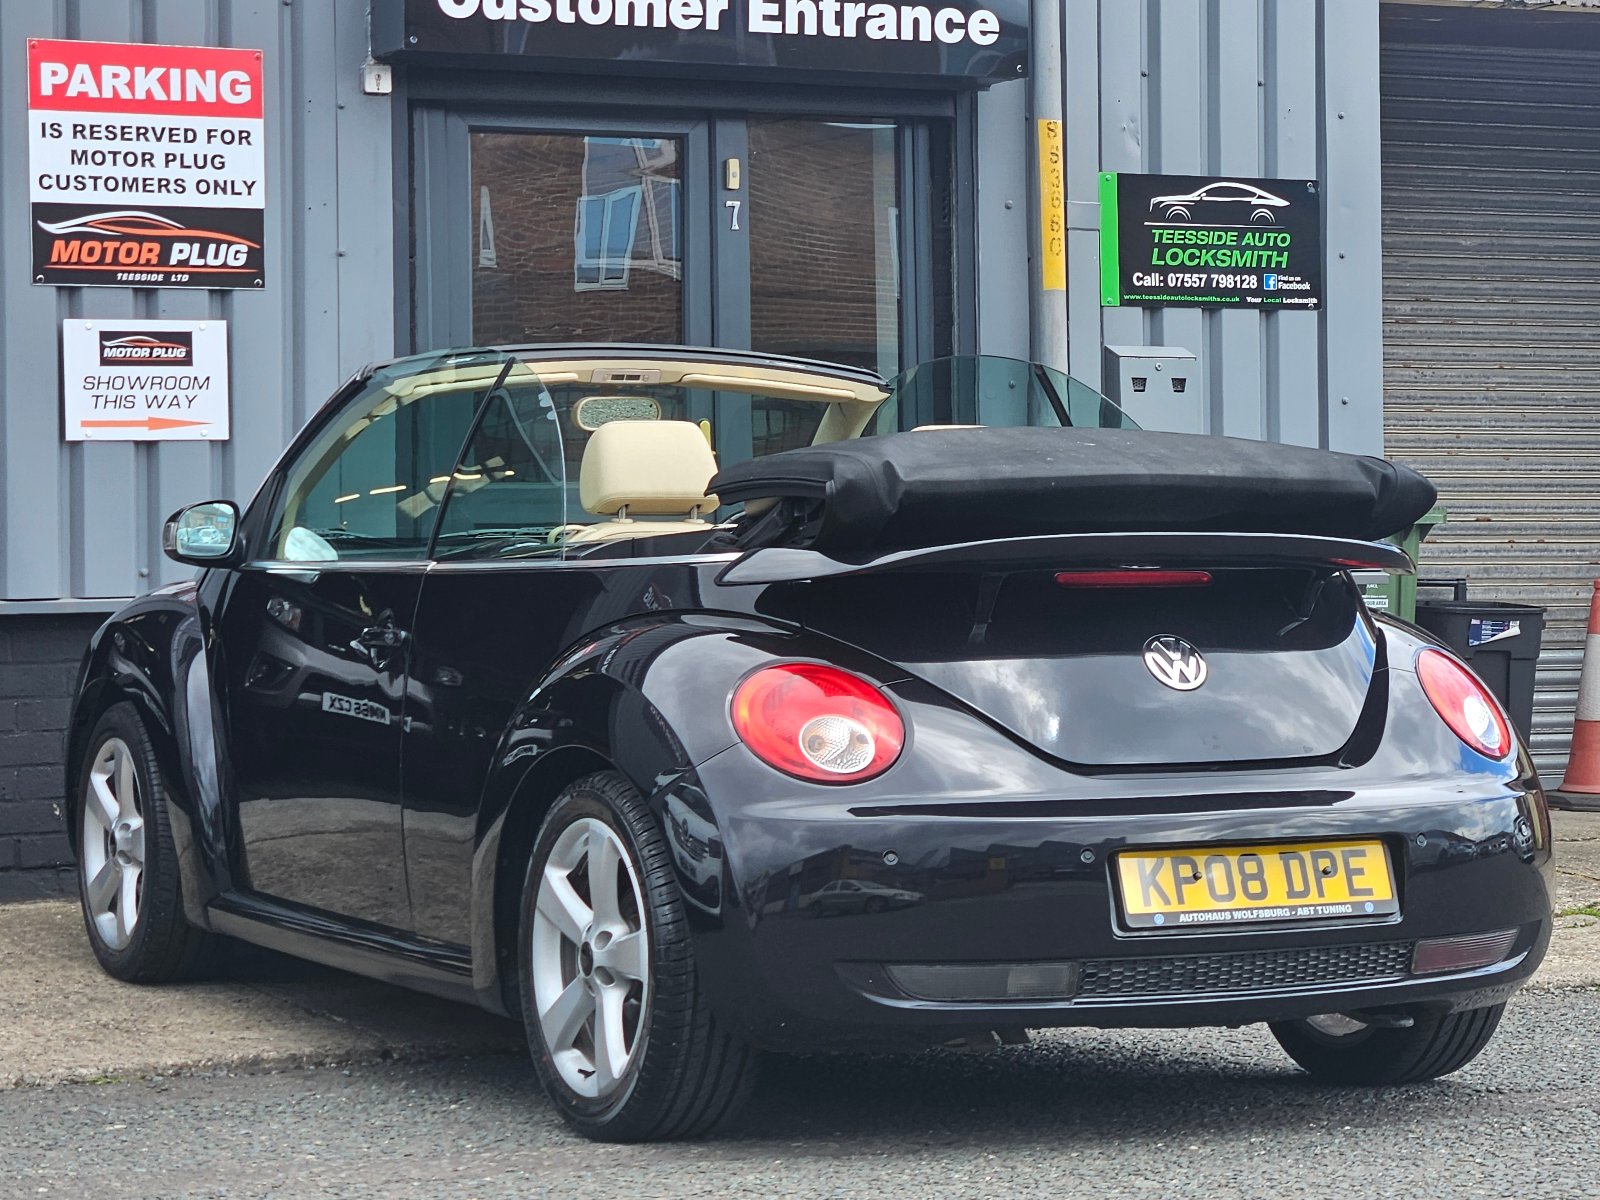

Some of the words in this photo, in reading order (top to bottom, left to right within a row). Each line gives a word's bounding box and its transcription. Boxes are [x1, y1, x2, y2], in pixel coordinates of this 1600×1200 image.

[748, 0, 1000, 45] Entrance
[40, 62, 251, 104] PARKING
[41, 122, 63, 139] IS
[72, 124, 198, 144] RESERVED
[206, 128, 252, 146] FOR
[70, 149, 156, 168] MOTOR
[164, 153, 226, 170] PLUG
[38, 174, 187, 194] CUSTOMERS
[196, 179, 257, 197] ONLY
[725, 201, 741, 230] 7
[1152, 229, 1238, 246] TEESSIDE
[1242, 231, 1291, 247] AUTO
[51, 240, 161, 266] MOTOR
[169, 243, 248, 267] PLUG
[1152, 247, 1289, 269] LOCKSMITH
[116, 273, 164, 282] TEESSIDE
[171, 273, 189, 282] LTD
[1132, 272, 1164, 287] Call:
[1168, 273, 1207, 288] 07557
[1211, 273, 1258, 289] 798128
[1278, 282, 1311, 290] Facebook
[103, 347, 150, 358] MOTOR
[152, 348, 187, 358] PLUG
[83, 375, 210, 391] SHOWROOM
[91, 394, 136, 409] THIS
[145, 394, 198, 409] WAY
[1136, 853, 1269, 907] KP08
[1279, 849, 1374, 900] DPE
[1179, 911, 1231, 922] AUTOHAUS
[1232, 907, 1290, 920] WOLFSBURG
[1297, 906, 1315, 916] ABT
[1316, 904, 1353, 915] TUNING
